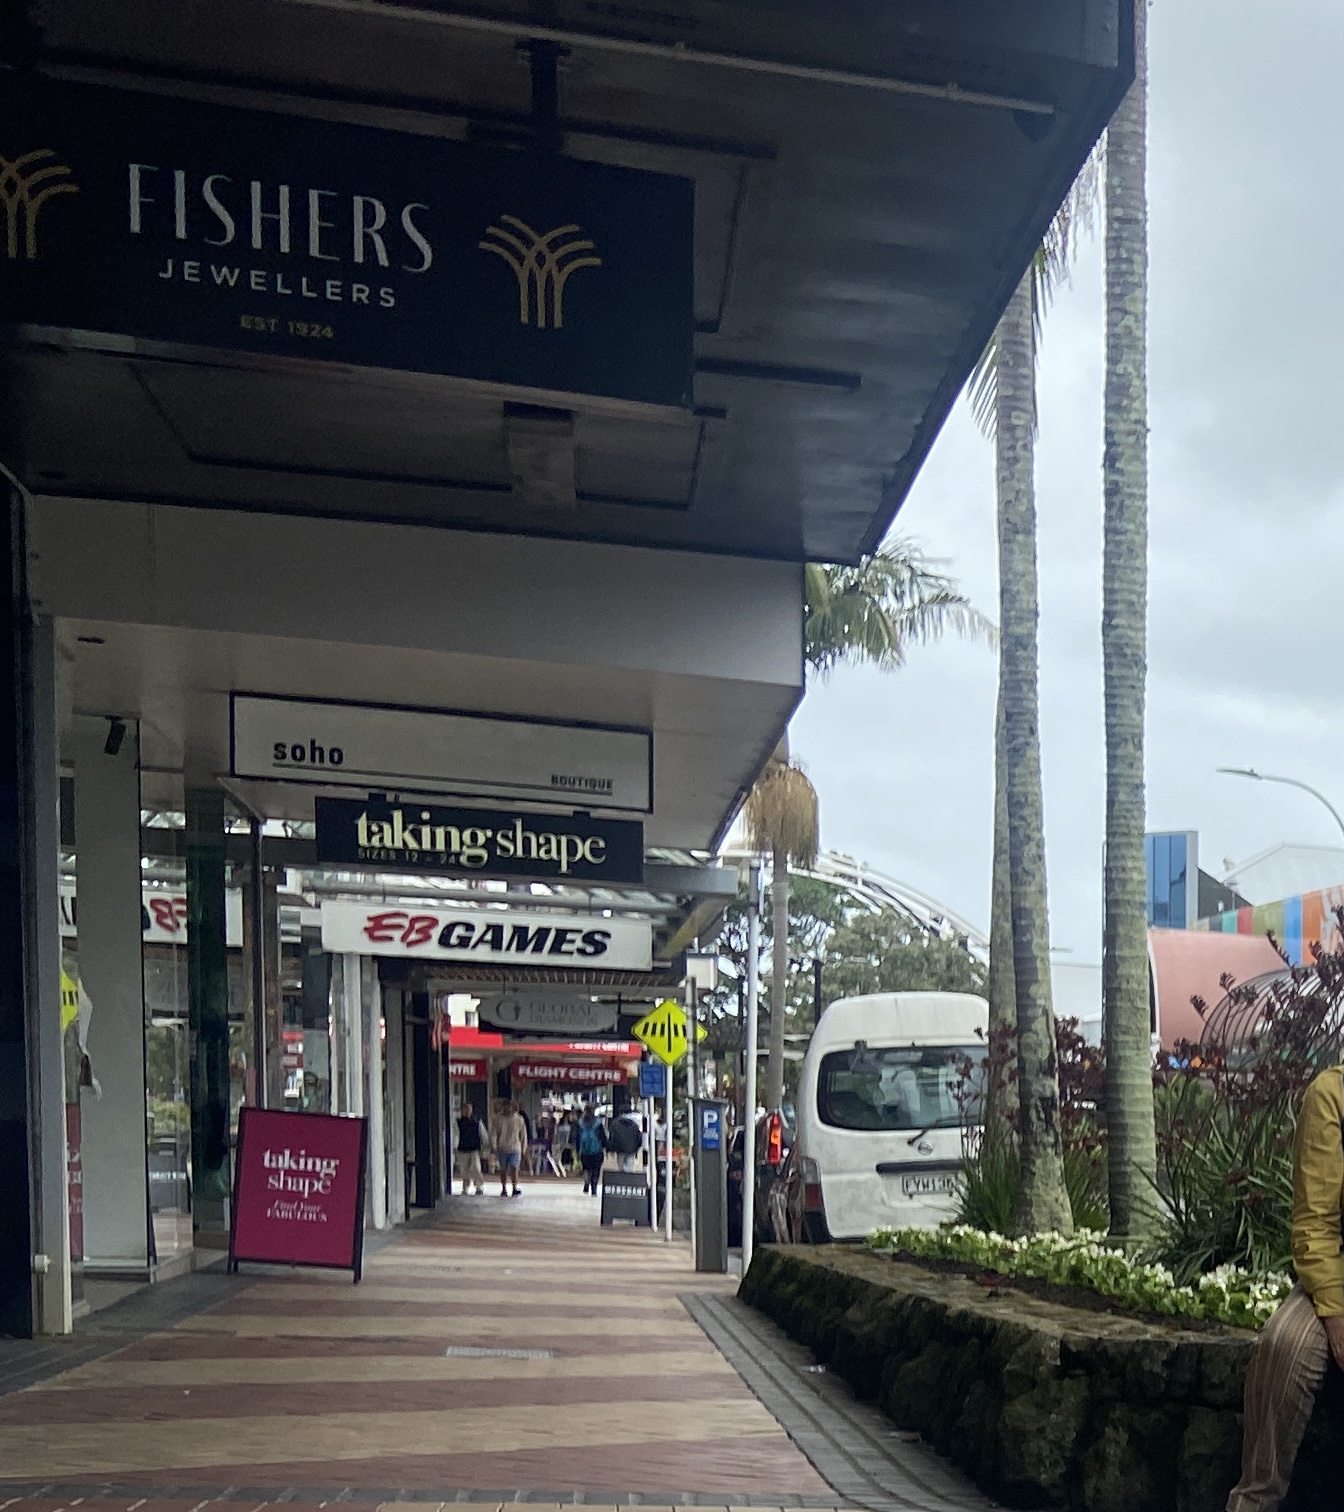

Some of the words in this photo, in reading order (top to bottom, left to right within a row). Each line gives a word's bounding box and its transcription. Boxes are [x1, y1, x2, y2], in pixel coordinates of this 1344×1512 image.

[128, 163, 434, 274] FISHERS
[159, 258, 396, 308] JEWELLERS
[240, 314, 280, 333] EST
[273, 738, 345, 766] soho
[550, 773, 614, 792] BOUTIQUE
[357, 809, 492, 868] taking
[496, 816, 607, 875] shape
[362, 911, 439, 948] EB
[437, 920, 613, 956] GAMES
[517, 1064, 568, 1079] FLIGHT
[568, 1067, 623, 1082] CENTRE
[703, 1109, 718, 1129] P
[263, 1148, 340, 1180] taking
[267, 1170, 332, 1198] shape
